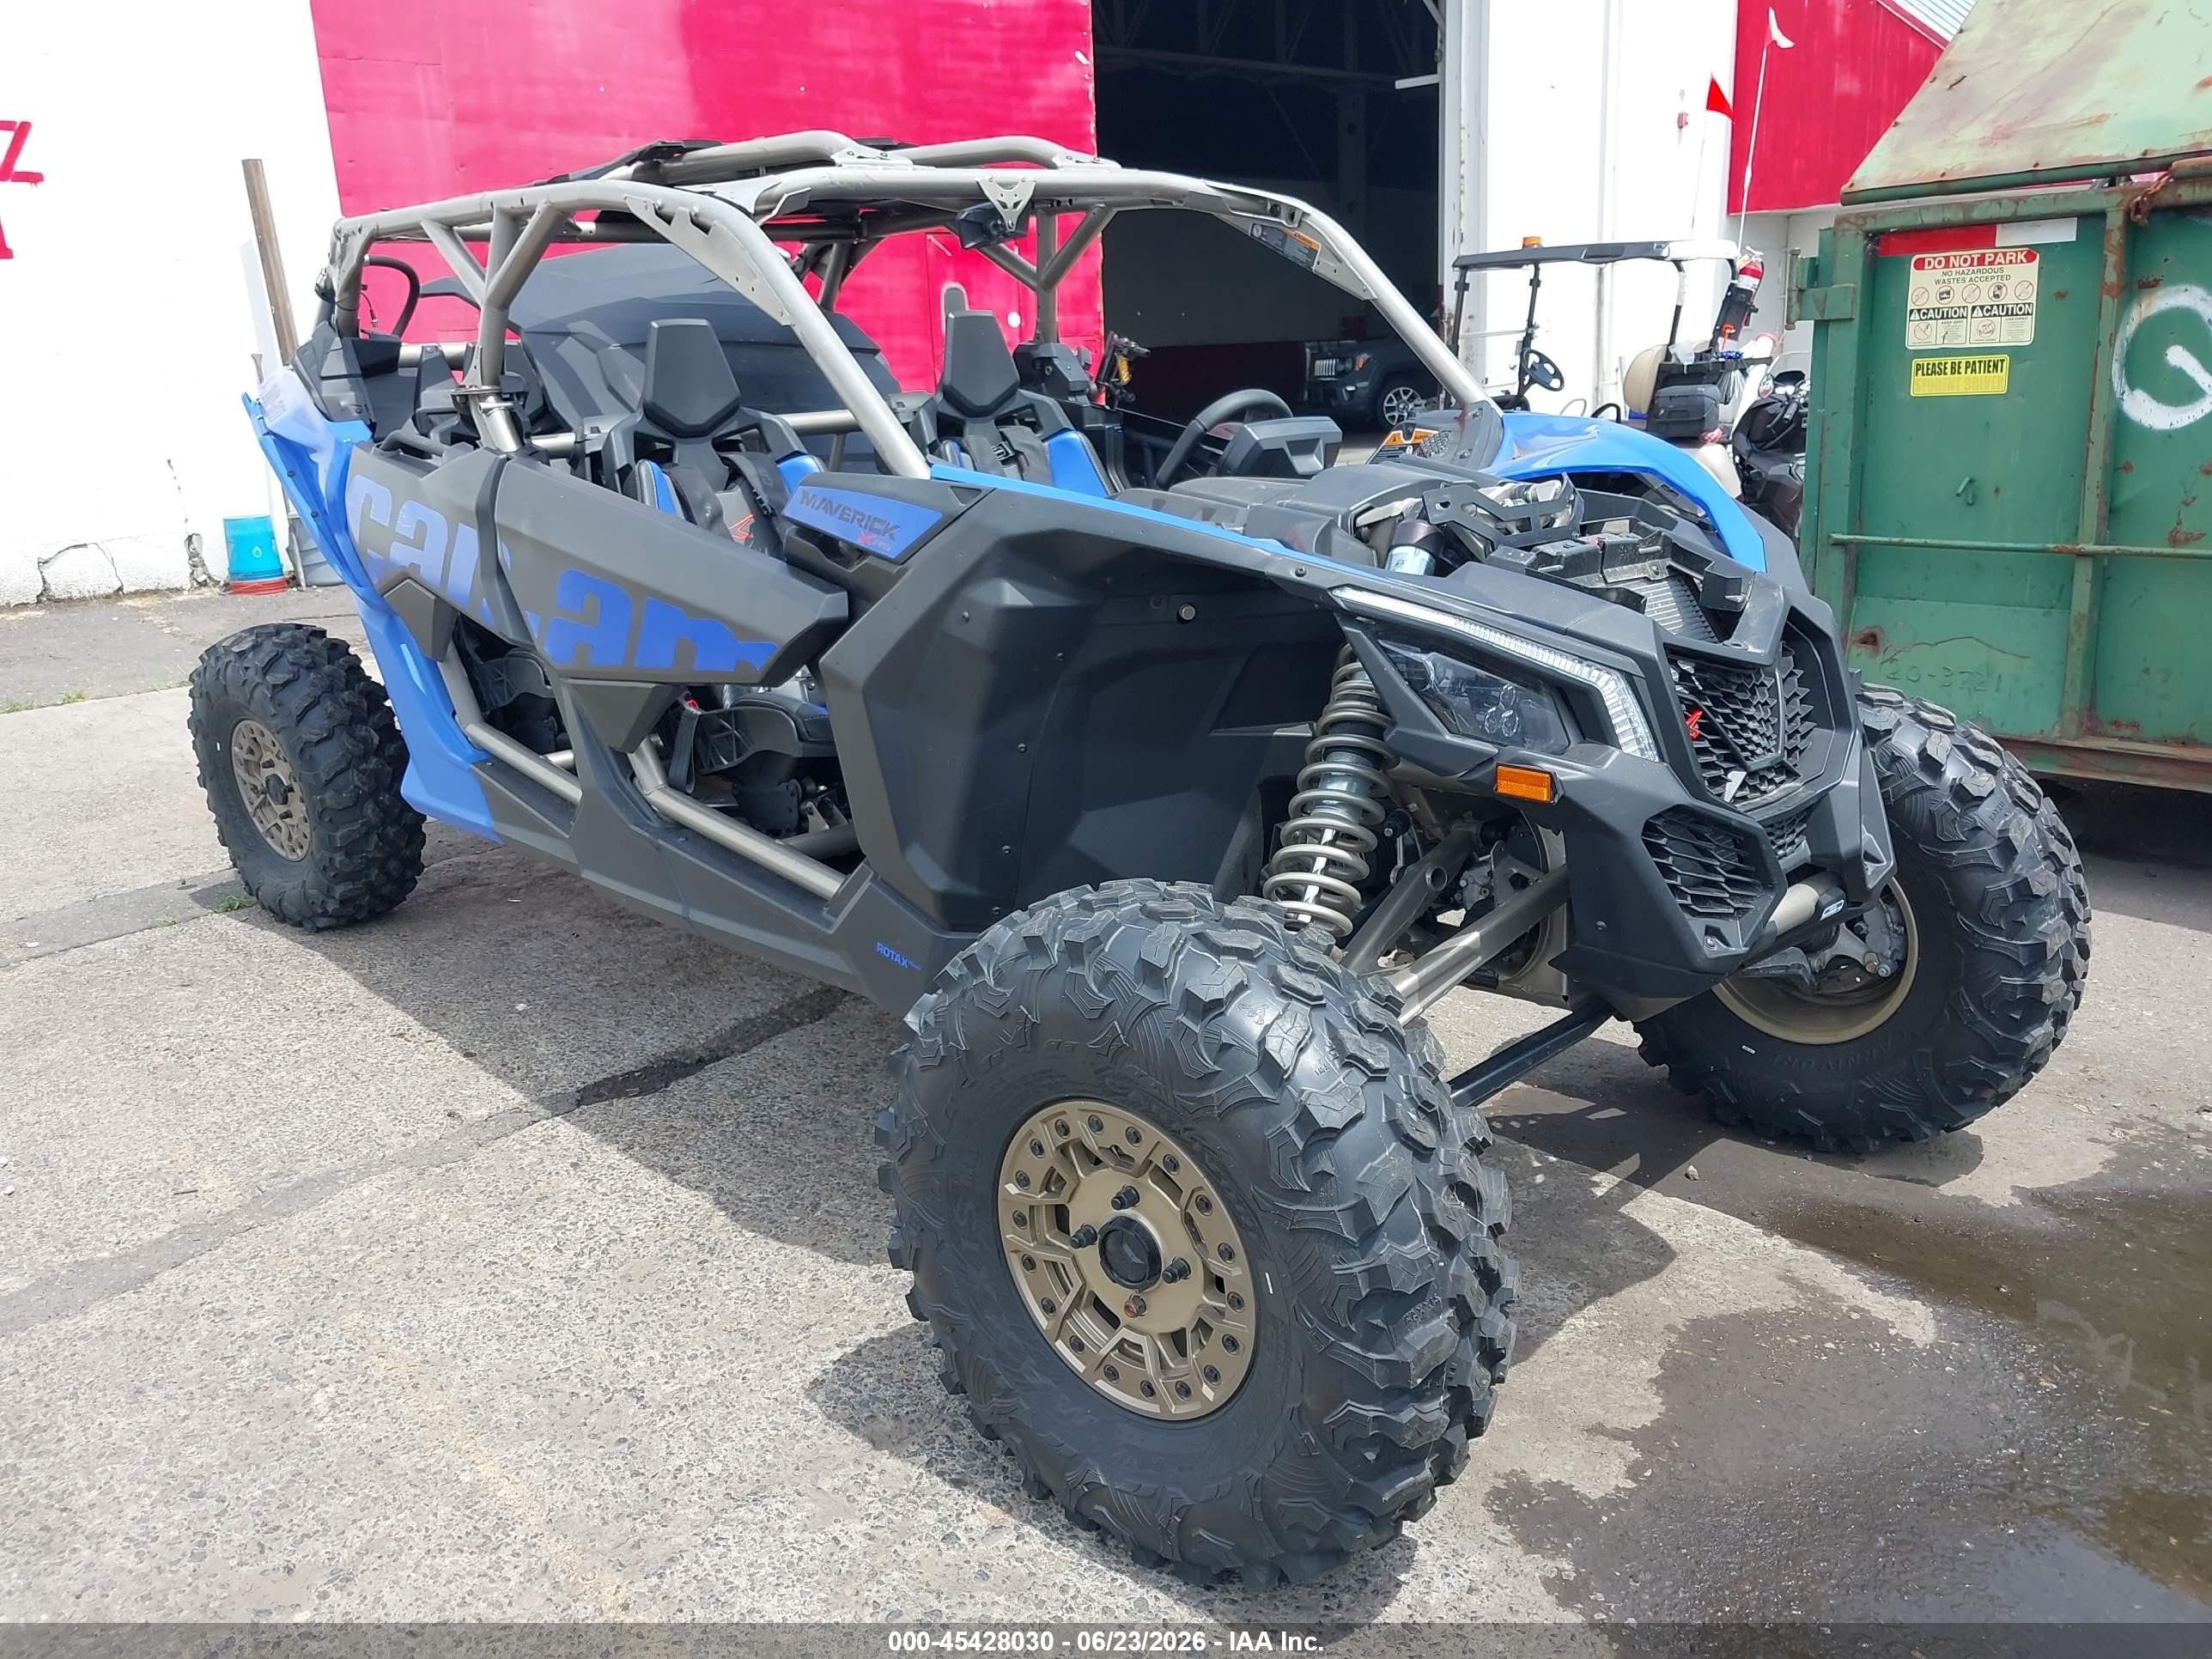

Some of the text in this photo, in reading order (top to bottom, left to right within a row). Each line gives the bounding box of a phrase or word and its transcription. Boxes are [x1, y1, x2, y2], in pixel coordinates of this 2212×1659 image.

[1924, 251, 2028, 270] DO NOT PARK
[1954, 267, 2004, 276] HAZARDOUS
[1935, 274, 2011, 285] WASTES ACCEPTED
[1920, 307, 1967, 319] CAUTION
[1983, 303, 2033, 316] CAUTION
[1915, 359, 2006, 377] PLEASE BE PATIENT
[799, 489, 900, 540] MAVERICK
[876, 941, 908, 969] ROTAX
